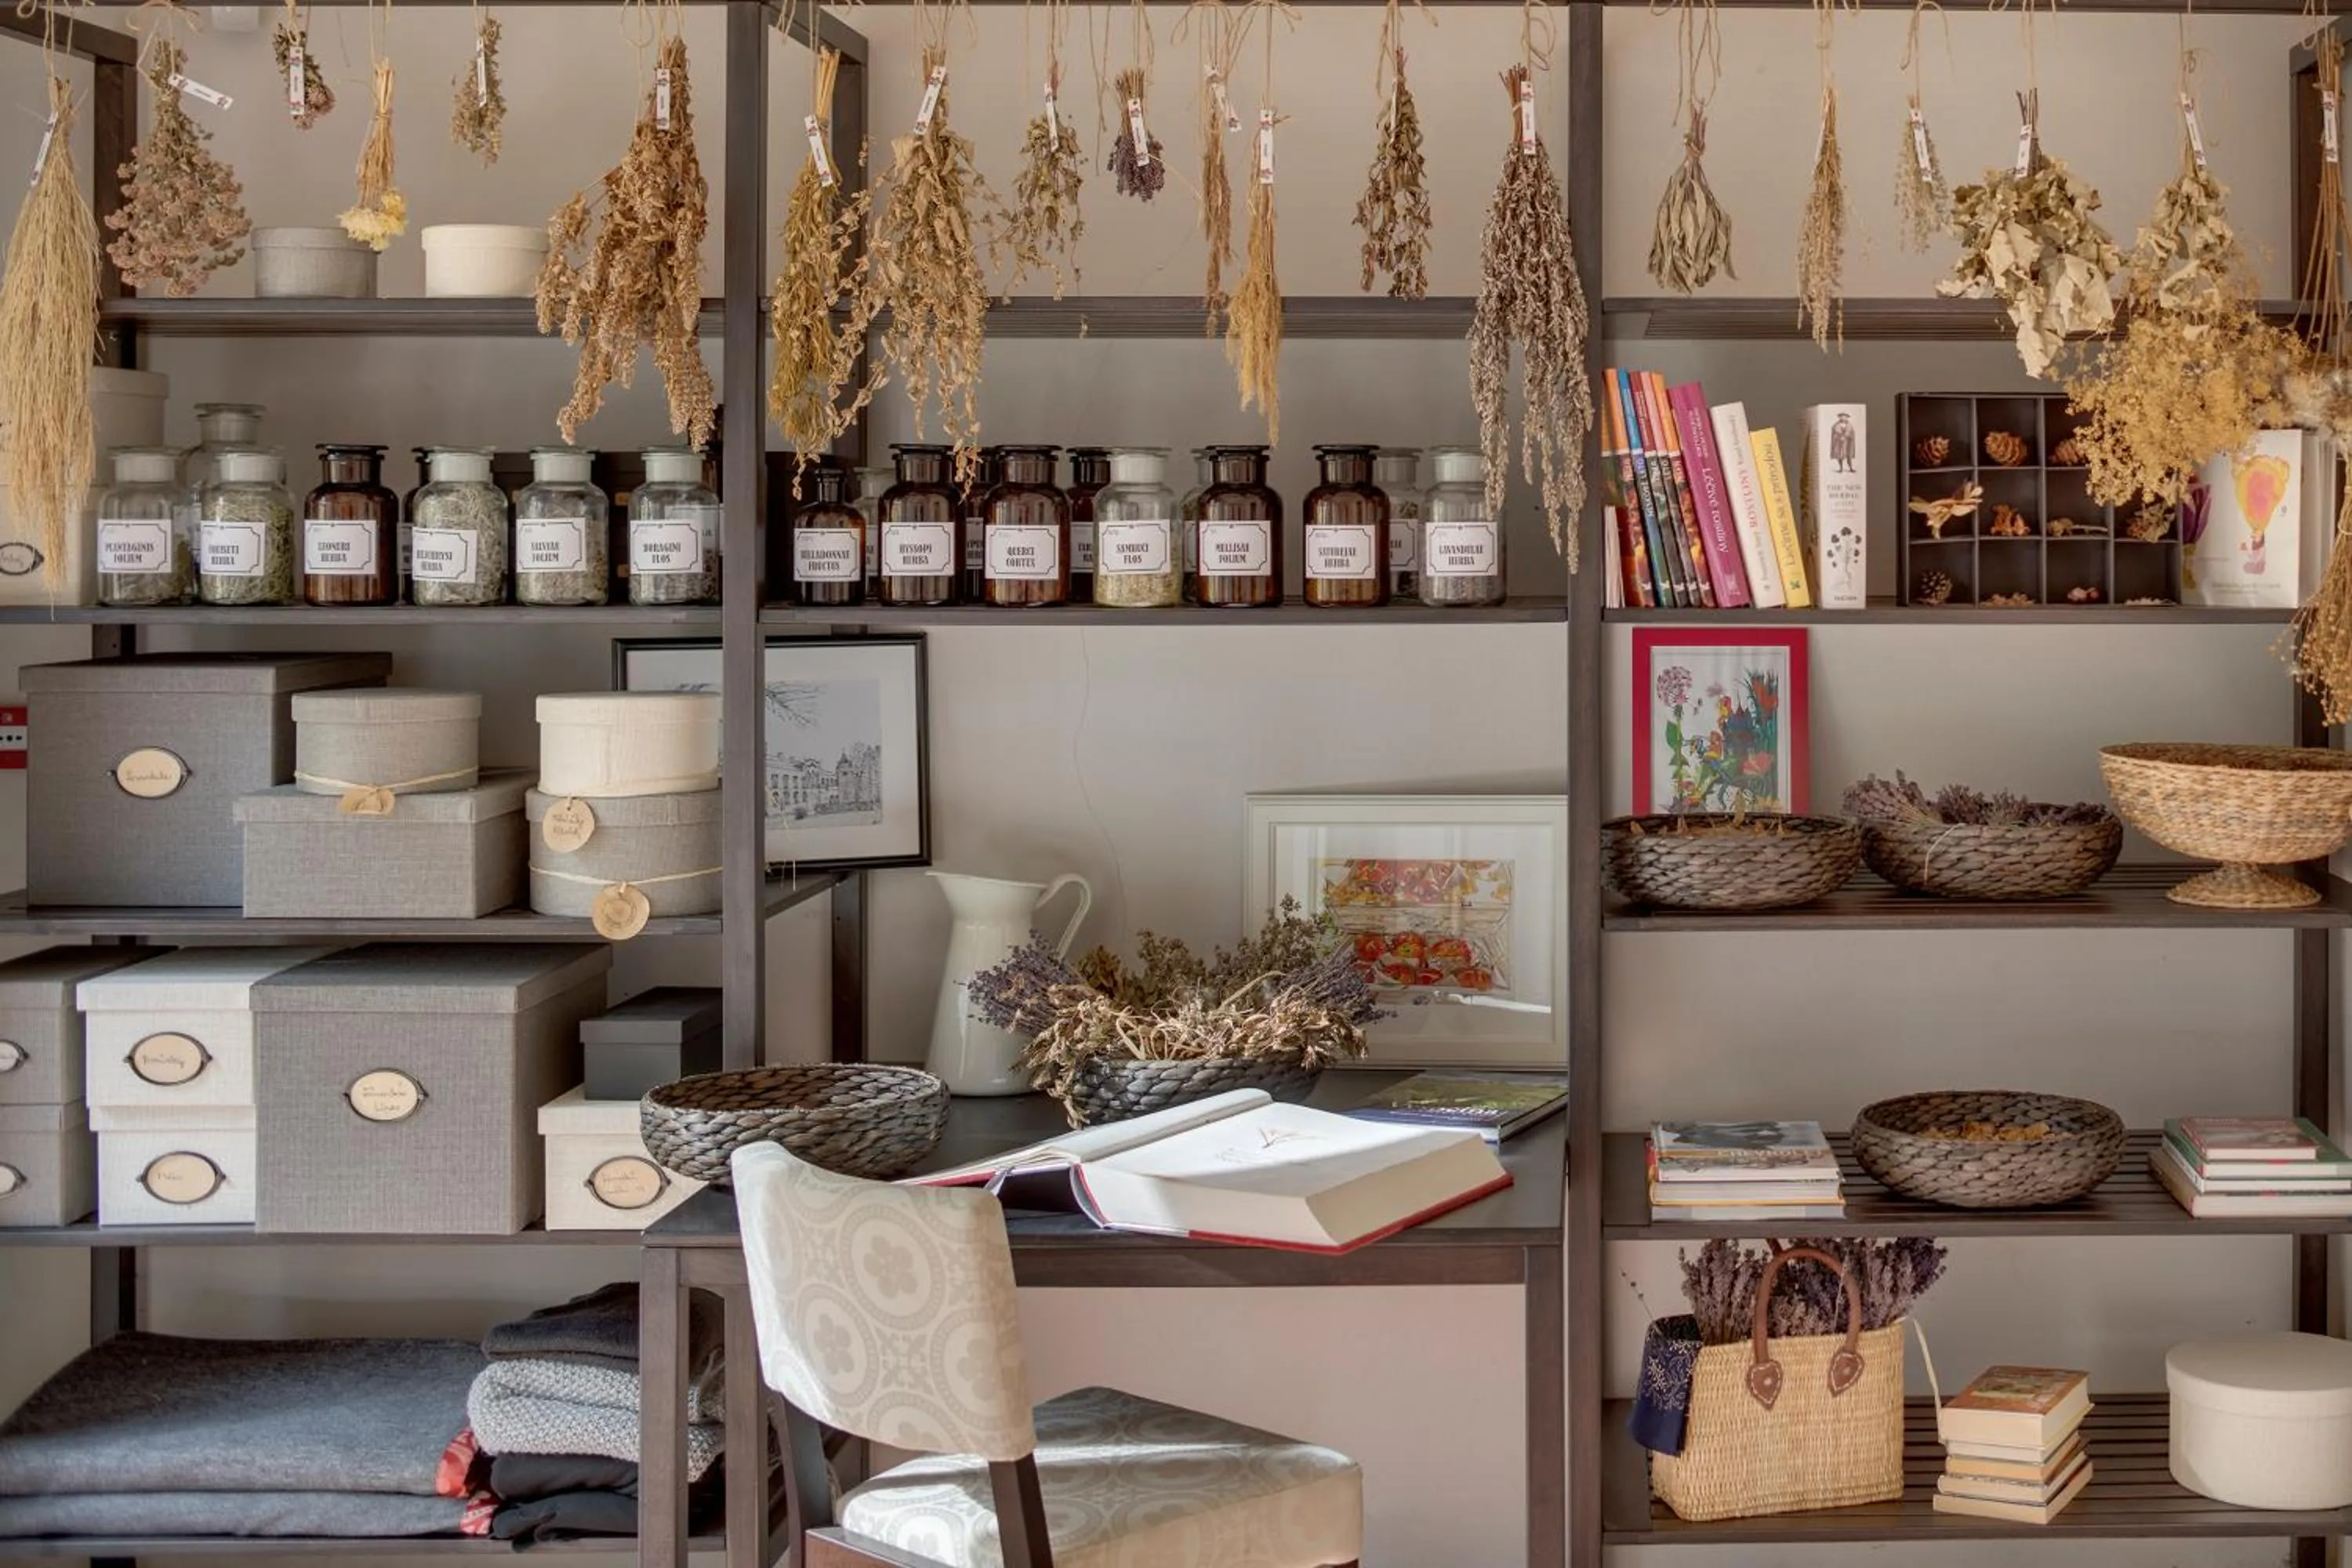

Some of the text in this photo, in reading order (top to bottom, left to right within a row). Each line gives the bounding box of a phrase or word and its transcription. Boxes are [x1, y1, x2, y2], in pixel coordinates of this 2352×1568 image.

[105, 542, 155, 553] PLANTAGINIS
[898, 543, 932, 554] HYSSOPI
[1007, 546, 1035, 556] QUERCI
[1116, 543, 1149, 553] SAMBUCI
[902, 555, 929, 564] HERBA
[1006, 557, 1036, 568] CORTEX
[1123, 554, 1142, 564] FLOS
[1219, 554, 1247, 563] FOLIUM
[1448, 556, 1475, 565] HERBA
